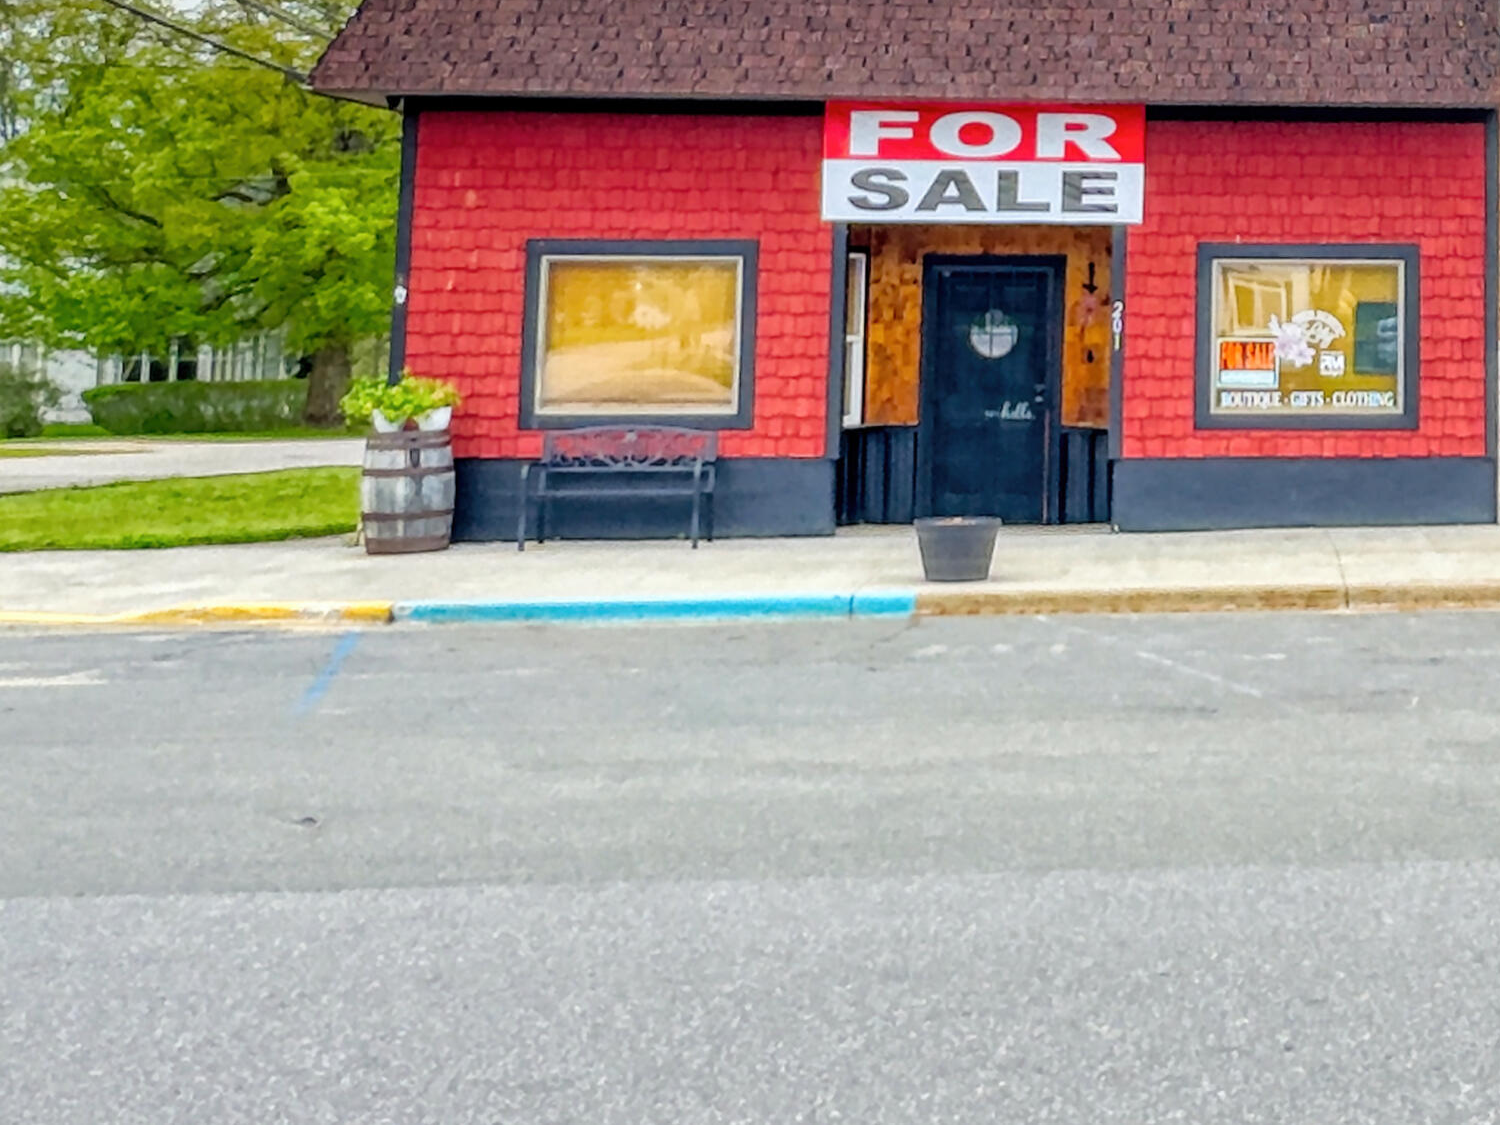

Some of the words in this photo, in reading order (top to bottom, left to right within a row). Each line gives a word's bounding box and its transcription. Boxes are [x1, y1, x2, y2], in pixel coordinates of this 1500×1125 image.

[849, 111, 1122, 160] FOR
[847, 168, 1119, 214] SALE
[1112, 300, 1124, 350] 201
[1220, 391, 1282, 409] BOUTIQUE
[1290, 391, 1325, 407] GIFTS
[1332, 391, 1394, 407] CLOTHING
